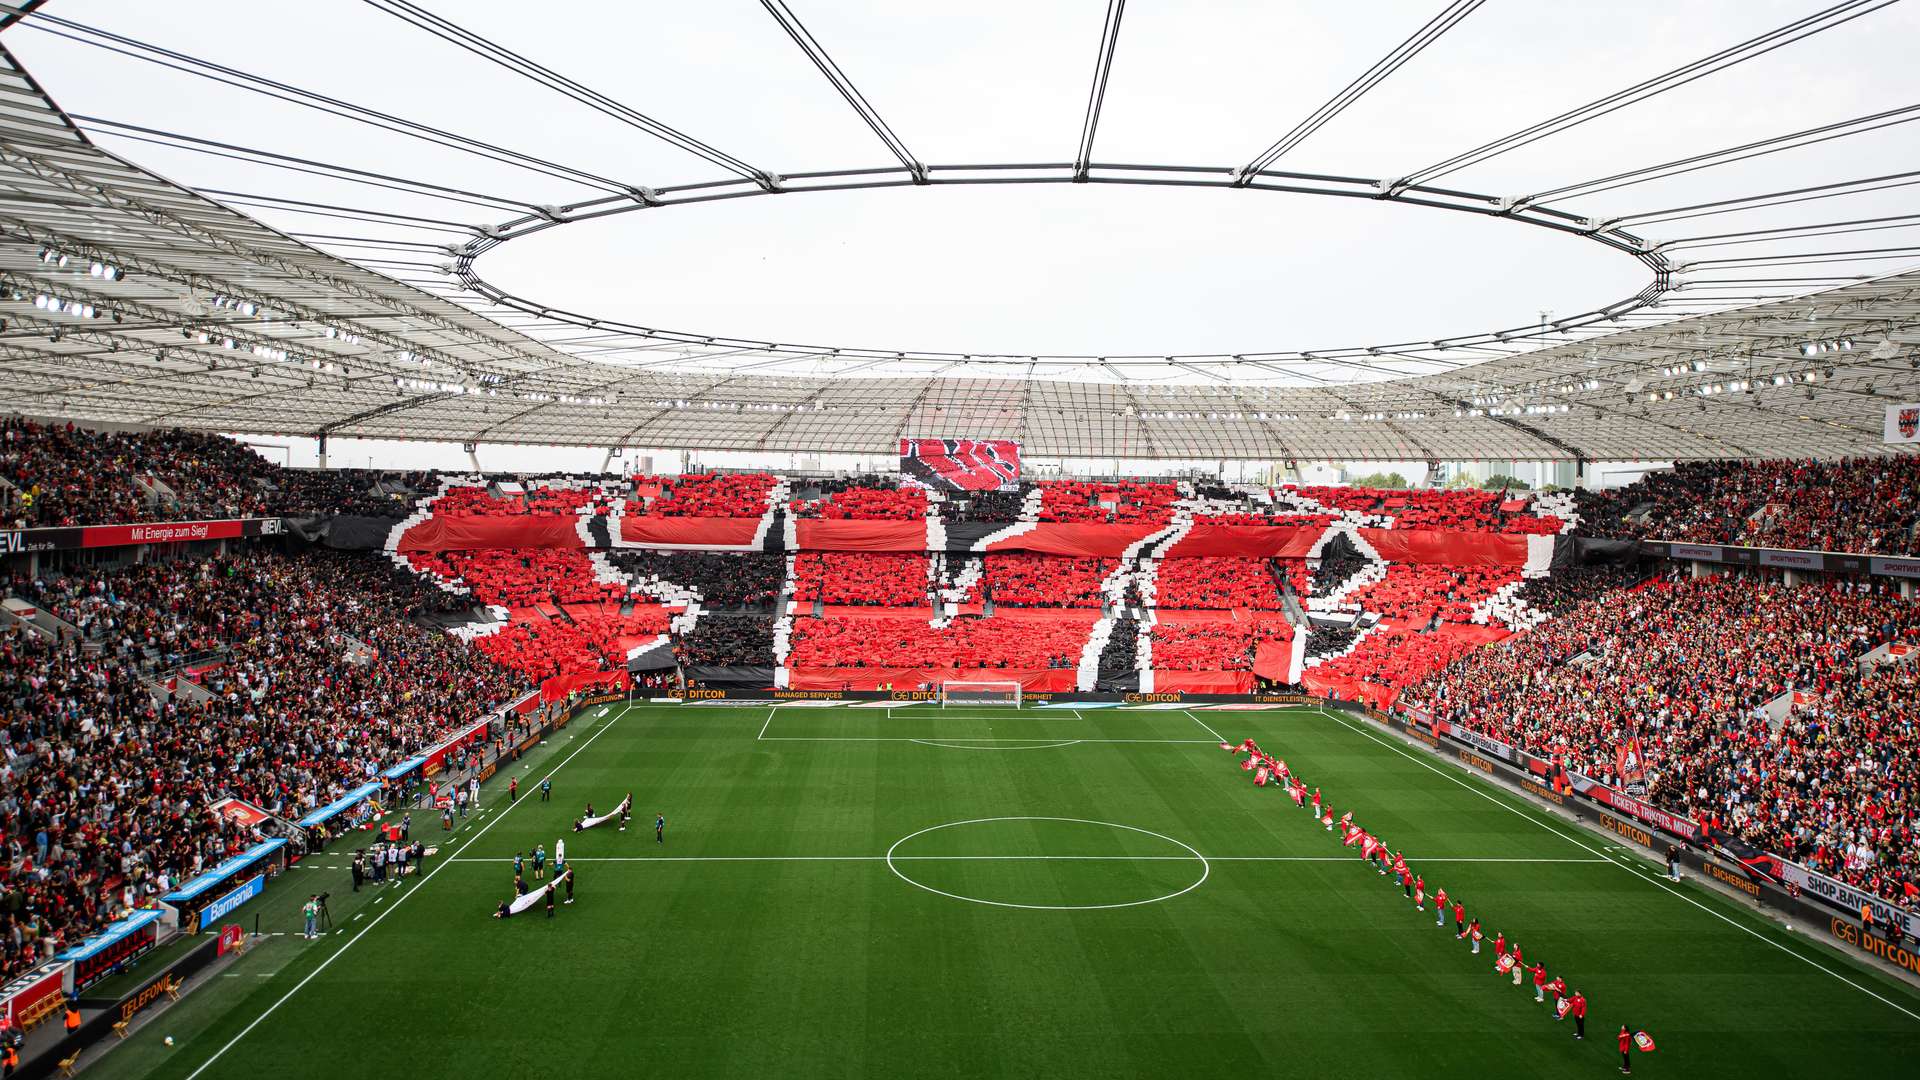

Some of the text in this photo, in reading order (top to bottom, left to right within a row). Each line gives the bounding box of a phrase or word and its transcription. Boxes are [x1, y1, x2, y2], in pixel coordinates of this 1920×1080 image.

[132, 521, 208, 542] Mit Energie zum Sieg!
[1679, 548, 1713, 556] SPORTWETTEN
[1769, 554, 1812, 564] SPORTWETTEN
[689, 690, 726, 699] DITCON
[774, 691, 843, 699] MANAGED SERVICES
[1013, 692, 1053, 700] SCHERHEIT
[1146, 693, 1181, 703] DITCON
[1460, 729, 1500, 754] SHOP.BAYER04.DE
[1470, 752, 1495, 774] DITCON
[1519, 777, 1538, 794] CLOUD
[1609, 791, 1639, 816] TICKETS,
[1640, 804, 1673, 830] TRIKOTS,
[1617, 820, 1651, 848] DITCON
[1703, 861, 1761, 897] IT SICHERHEIT
[210, 884, 254, 921] Barmenia
[1807, 875, 1911, 932] SHOP.BAYR04DE
[1862, 932, 1920, 976] DITCON
[121, 972, 173, 1020] TELEFONIE
